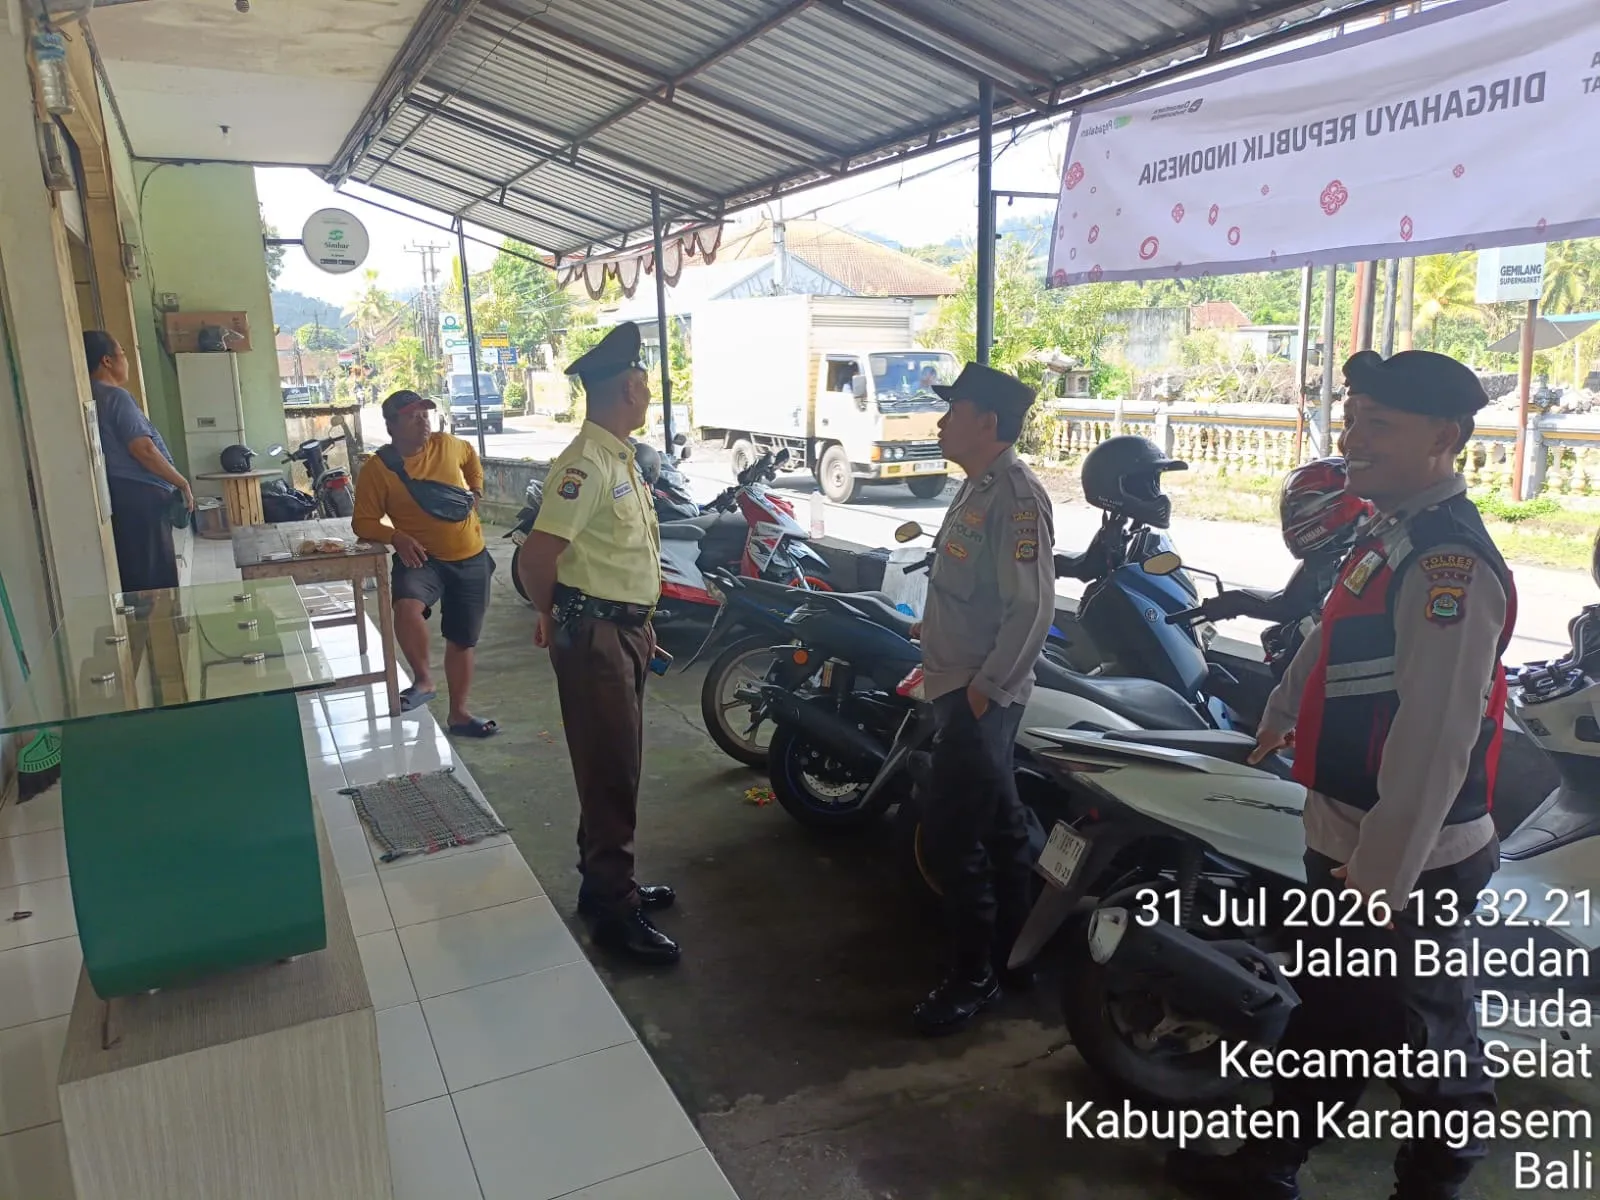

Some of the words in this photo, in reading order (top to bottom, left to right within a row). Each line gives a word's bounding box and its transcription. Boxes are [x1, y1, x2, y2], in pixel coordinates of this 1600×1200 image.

[1500, 264, 1542, 276] GEMILANG
[1499, 276, 1541, 285] SUPERMARKET
[1421, 555, 1473, 570] POLRES
